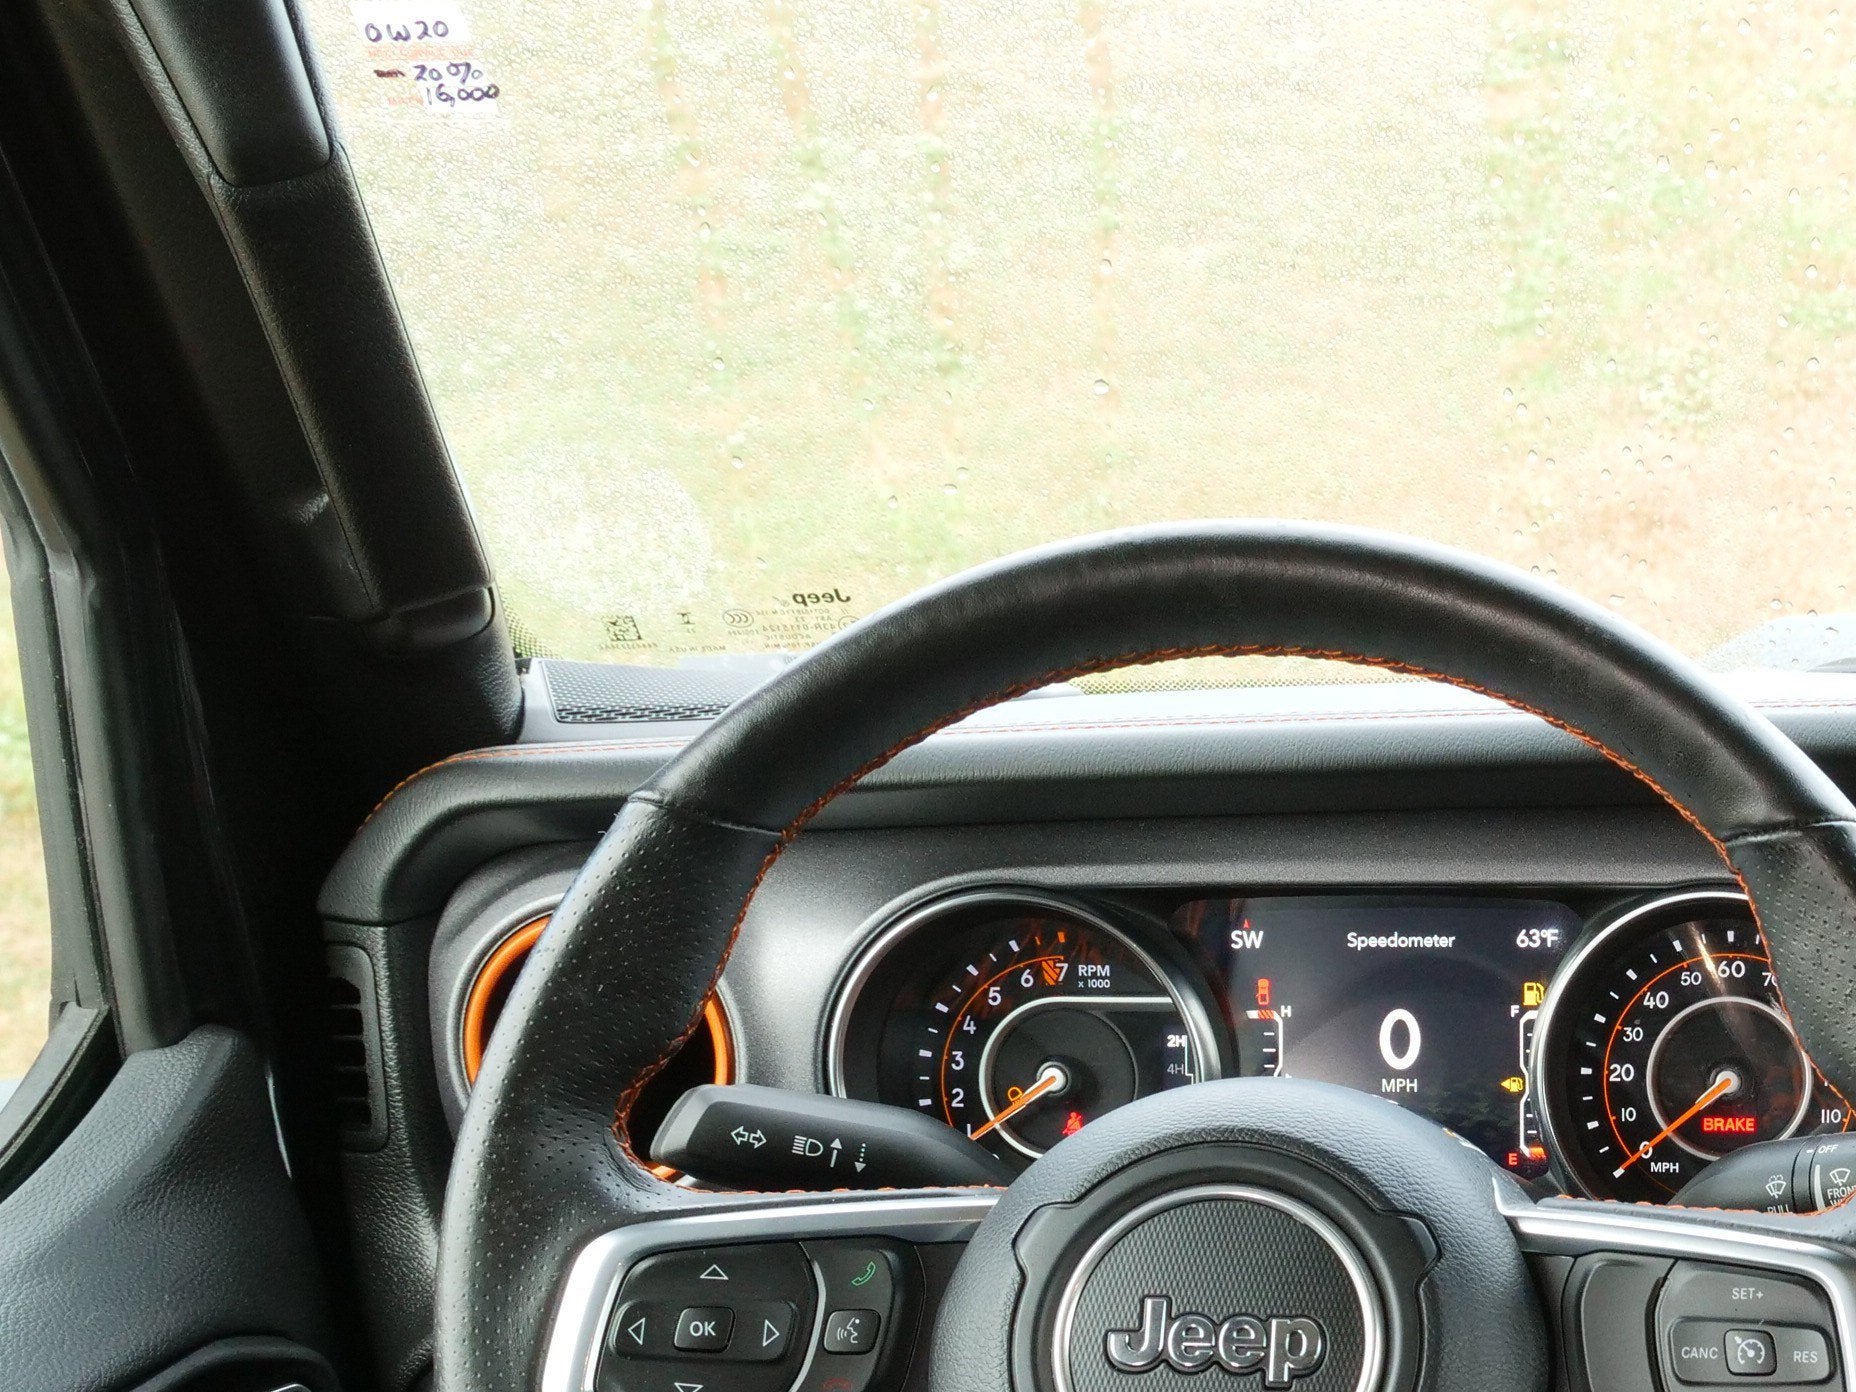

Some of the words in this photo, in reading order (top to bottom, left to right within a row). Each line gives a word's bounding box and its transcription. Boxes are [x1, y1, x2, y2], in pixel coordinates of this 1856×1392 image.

[1231, 931, 1264, 949] SW
[1347, 932, 1456, 951] Speedometer
[1055, 963, 1069, 983] 7
[1078, 965, 1111, 977] RPM
[1717, 961, 1746, 978] 60
[1020, 970, 1034, 988] 6
[1088, 979, 1111, 989] 1000
[1680, 971, 1702, 986] 50
[987, 988, 1002, 1006] 5
[1643, 991, 1670, 1009] 40
[1280, 1005, 1292, 1018] H
[1510, 1005, 1520, 1018] F
[962, 1017, 977, 1034] 4
[1166, 1034, 1187, 1048] 2H
[1379, 1008, 1421, 1070] 0
[1622, 1027, 1644, 1042] 30
[951, 1051, 964, 1070] 3
[1166, 1062, 1185, 1075] 4H
[1609, 1064, 1635, 1082] 20
[1381, 1079, 1418, 1093] MPH
[951, 1090, 965, 1108] 2
[1621, 1108, 1637, 1122] 10
[1820, 1108, 1841, 1124] 110
[1702, 1117, 1756, 1133] BRAKE
[1818, 1144, 1839, 1154] OFF
[1508, 1153, 1518, 1166] E
[1650, 1161, 1680, 1174] MPH
[689, 1321, 716, 1337] OK
[1107, 1295, 1327, 1388] Jeep
[1681, 1347, 1718, 1359] CANC
[1793, 1351, 1818, 1363] RES
